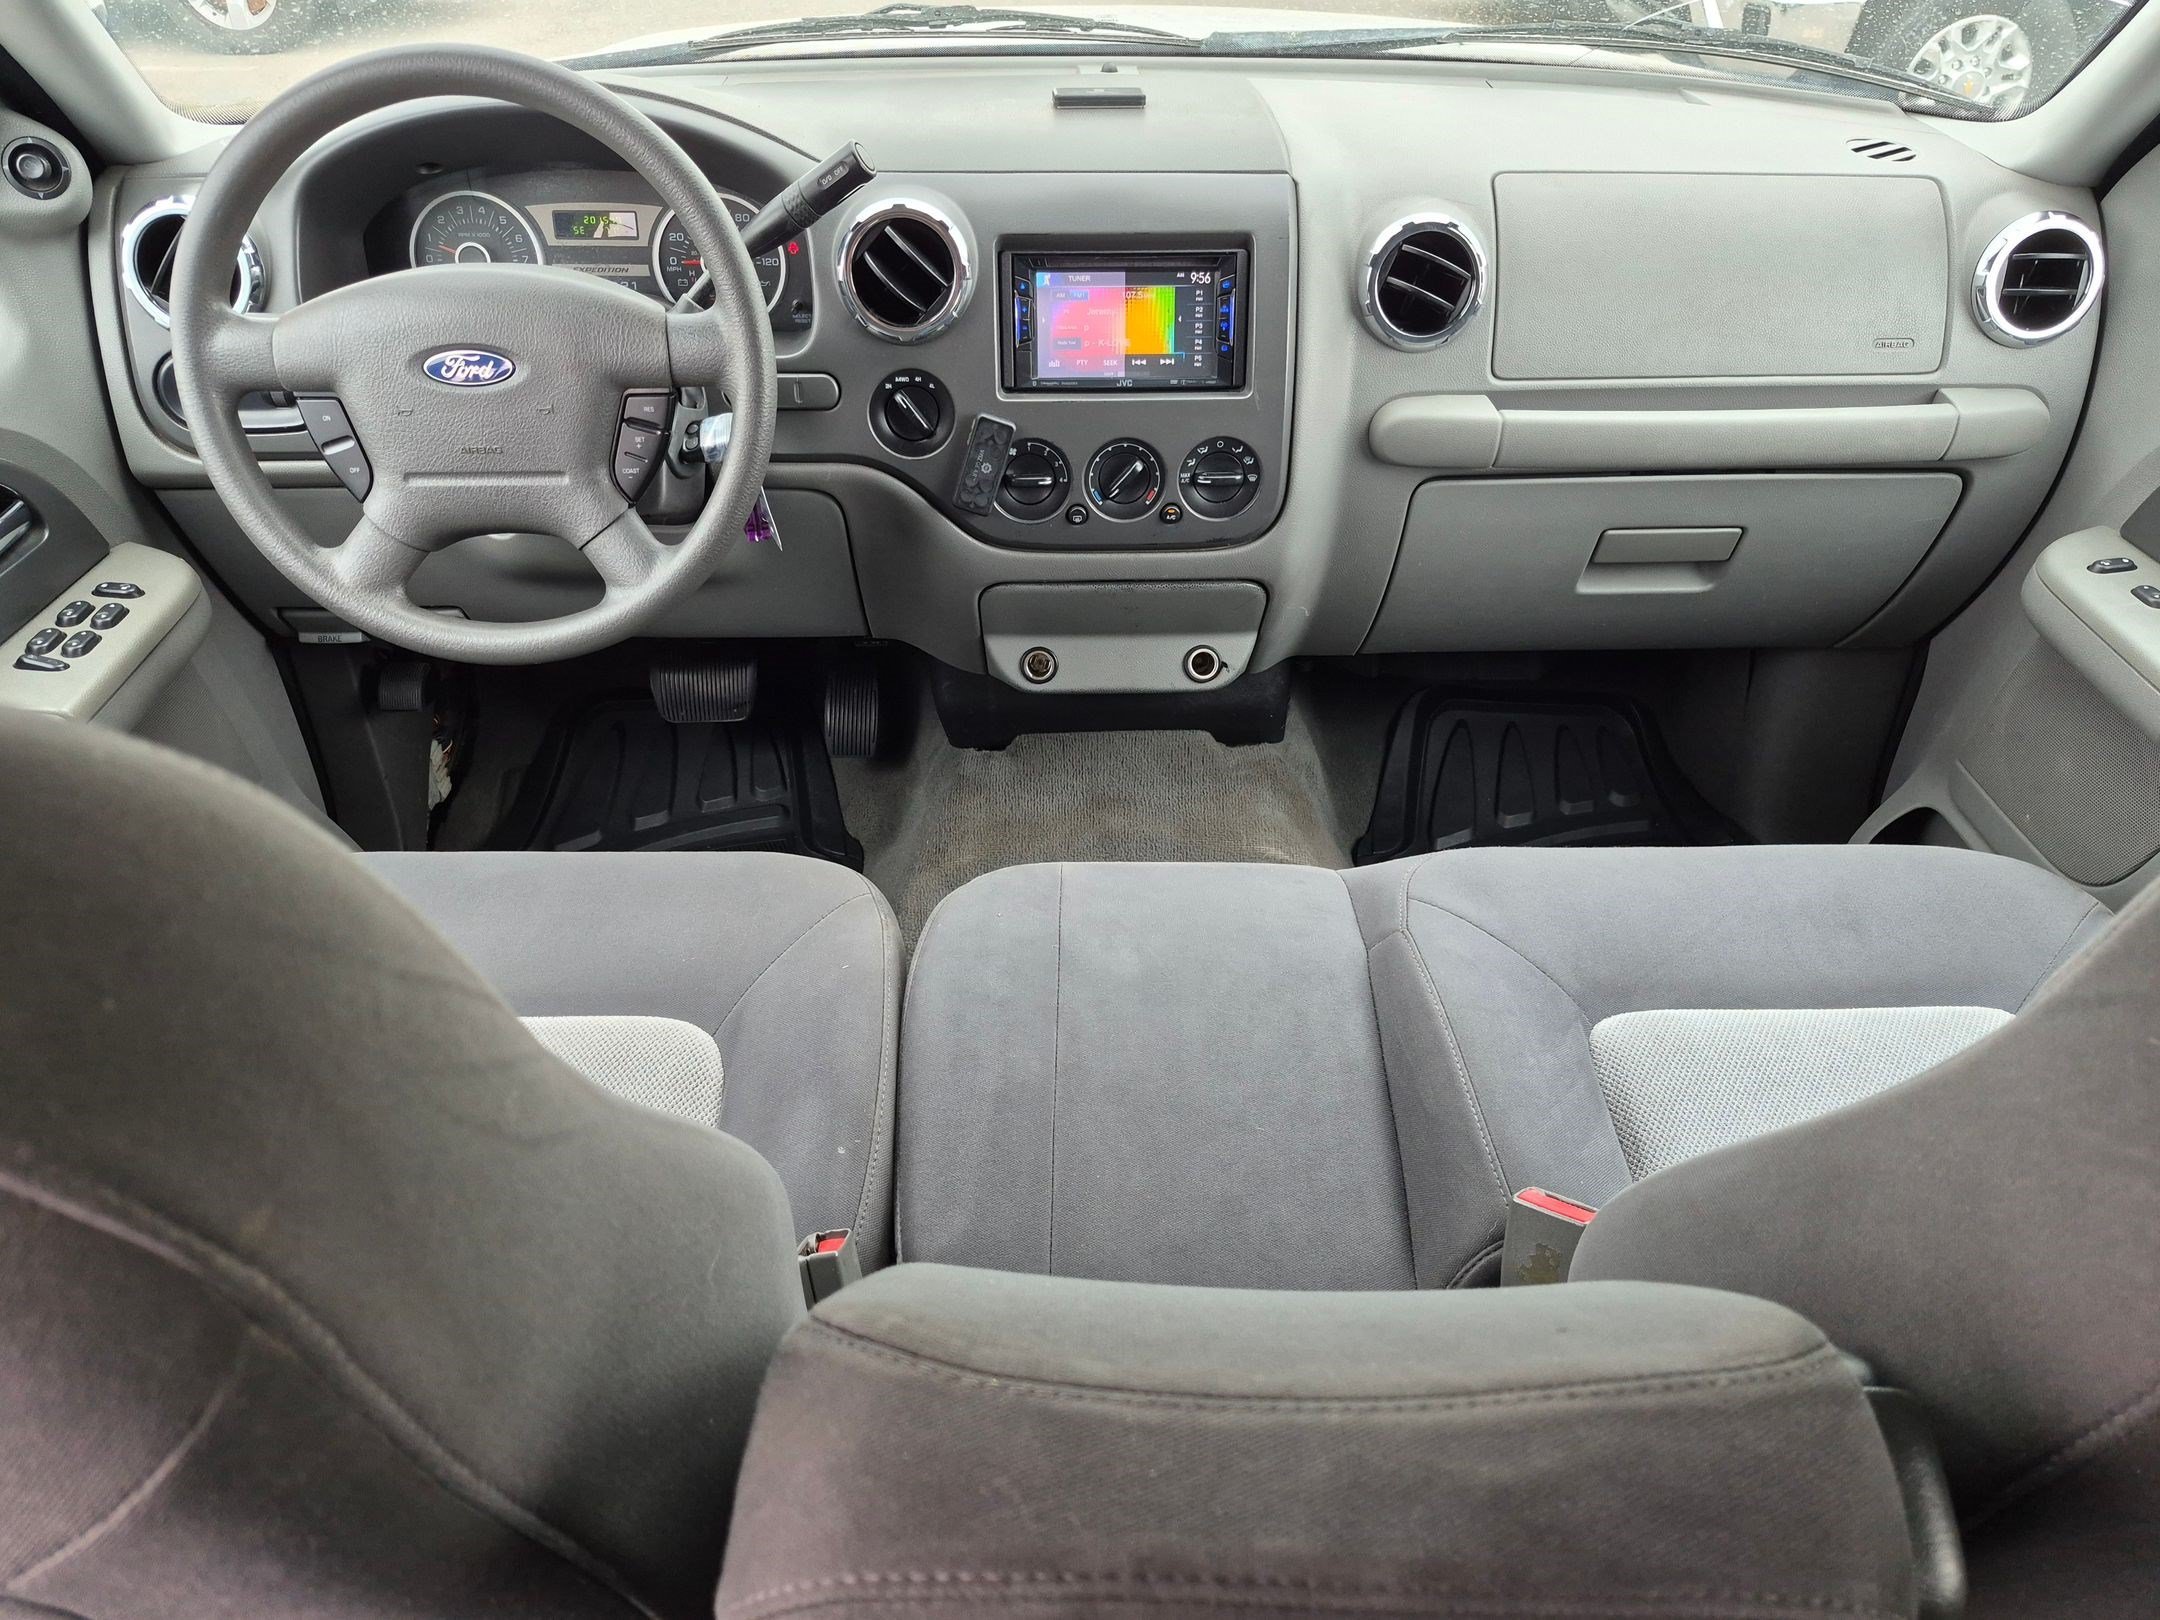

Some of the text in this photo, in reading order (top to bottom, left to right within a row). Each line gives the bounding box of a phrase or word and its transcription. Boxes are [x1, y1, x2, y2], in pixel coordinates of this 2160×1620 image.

[455, 206, 464, 215] 3
[478, 206, 486, 215] 4
[436, 215, 446, 224] 2
[499, 215, 507, 225] 5
[735, 213, 750, 222] 80
[428, 233, 432, 242] 1
[515, 234, 523, 243] 6
[669, 233, 684, 242] 20
[425, 254, 434, 263] 0
[521, 255, 529, 264] 7
[669, 256, 678, 266] 0
[761, 258, 779, 266] 120
[1190, 271, 1211, 284] 9:56
[441, 354, 495, 379] Ford
[1103, 359, 1118, 367] SEEK
[1116, 379, 1133, 387] JVC
[622, 467, 640, 475] COAST
[317, 635, 342, 643] BRAKE
